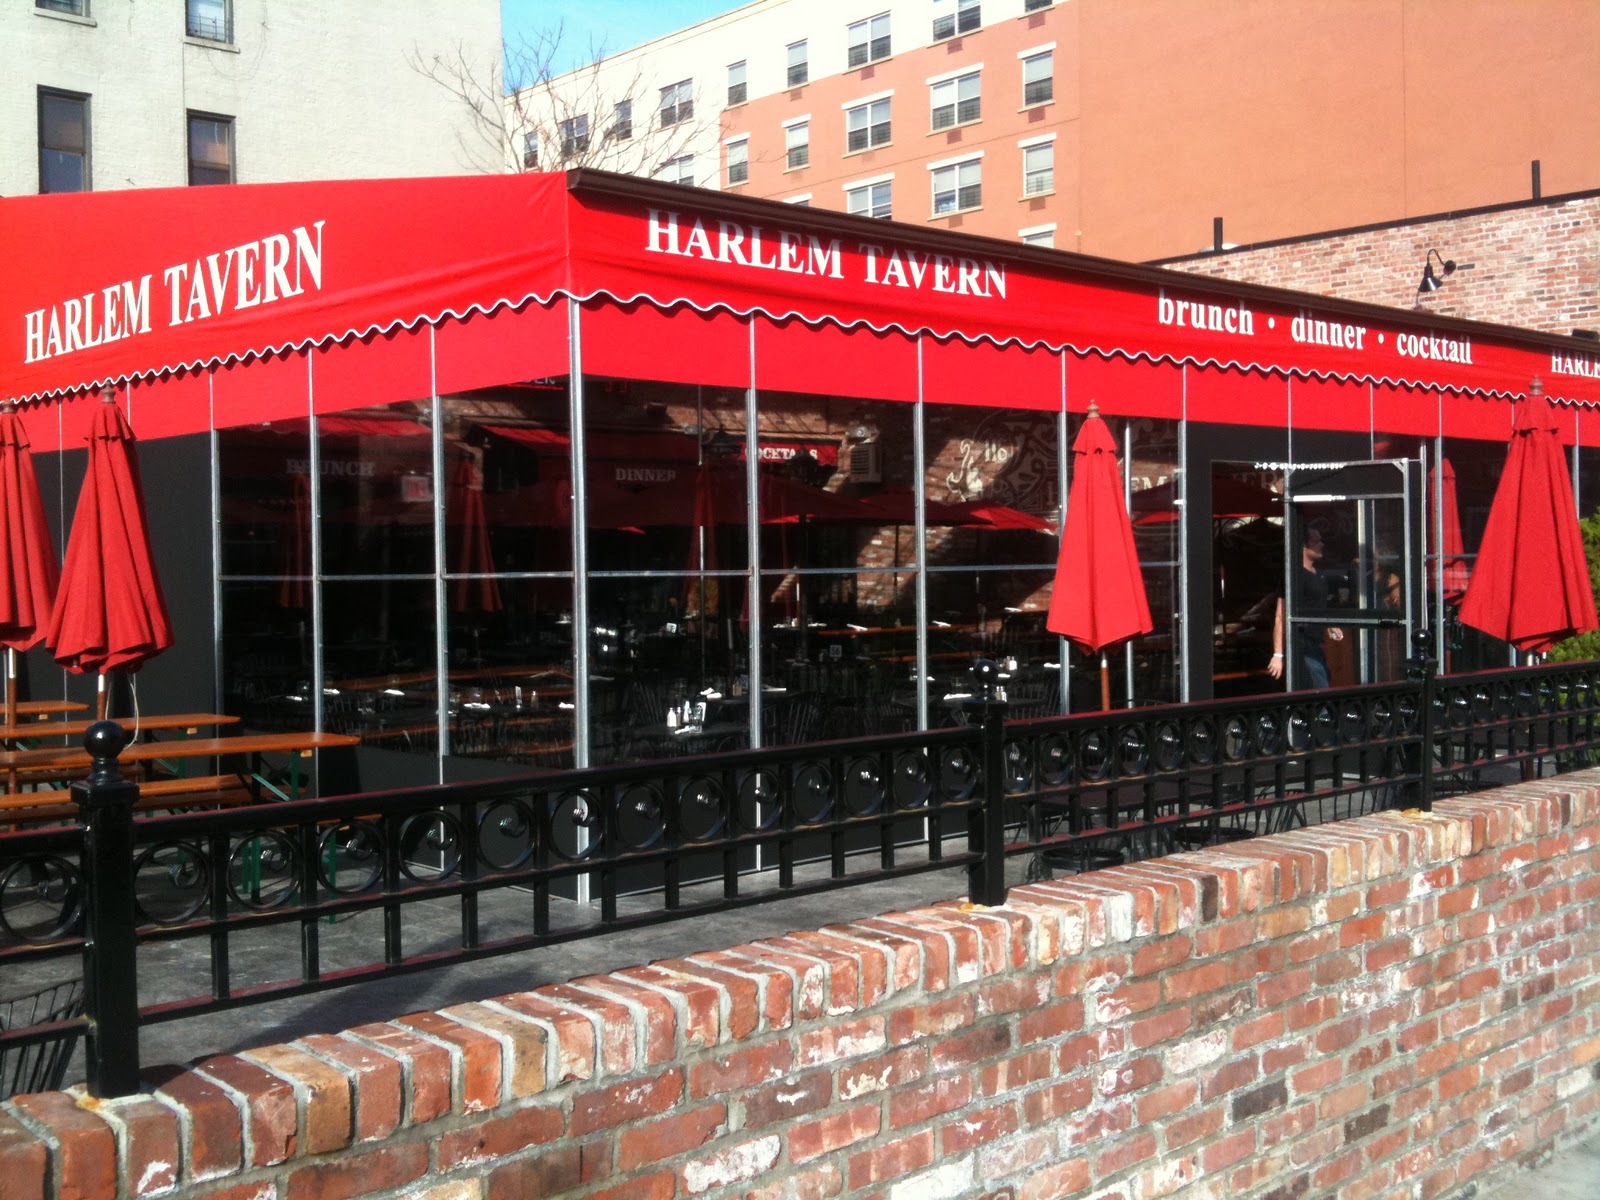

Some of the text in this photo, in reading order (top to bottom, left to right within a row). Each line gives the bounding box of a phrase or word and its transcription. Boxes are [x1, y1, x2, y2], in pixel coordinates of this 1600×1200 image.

[24, 220, 326, 364] HARLEM TAVERN
[645, 207, 1007, 299] HARLEM TAVERN
[1158, 287, 1473, 365] brunch dinner cocktail
